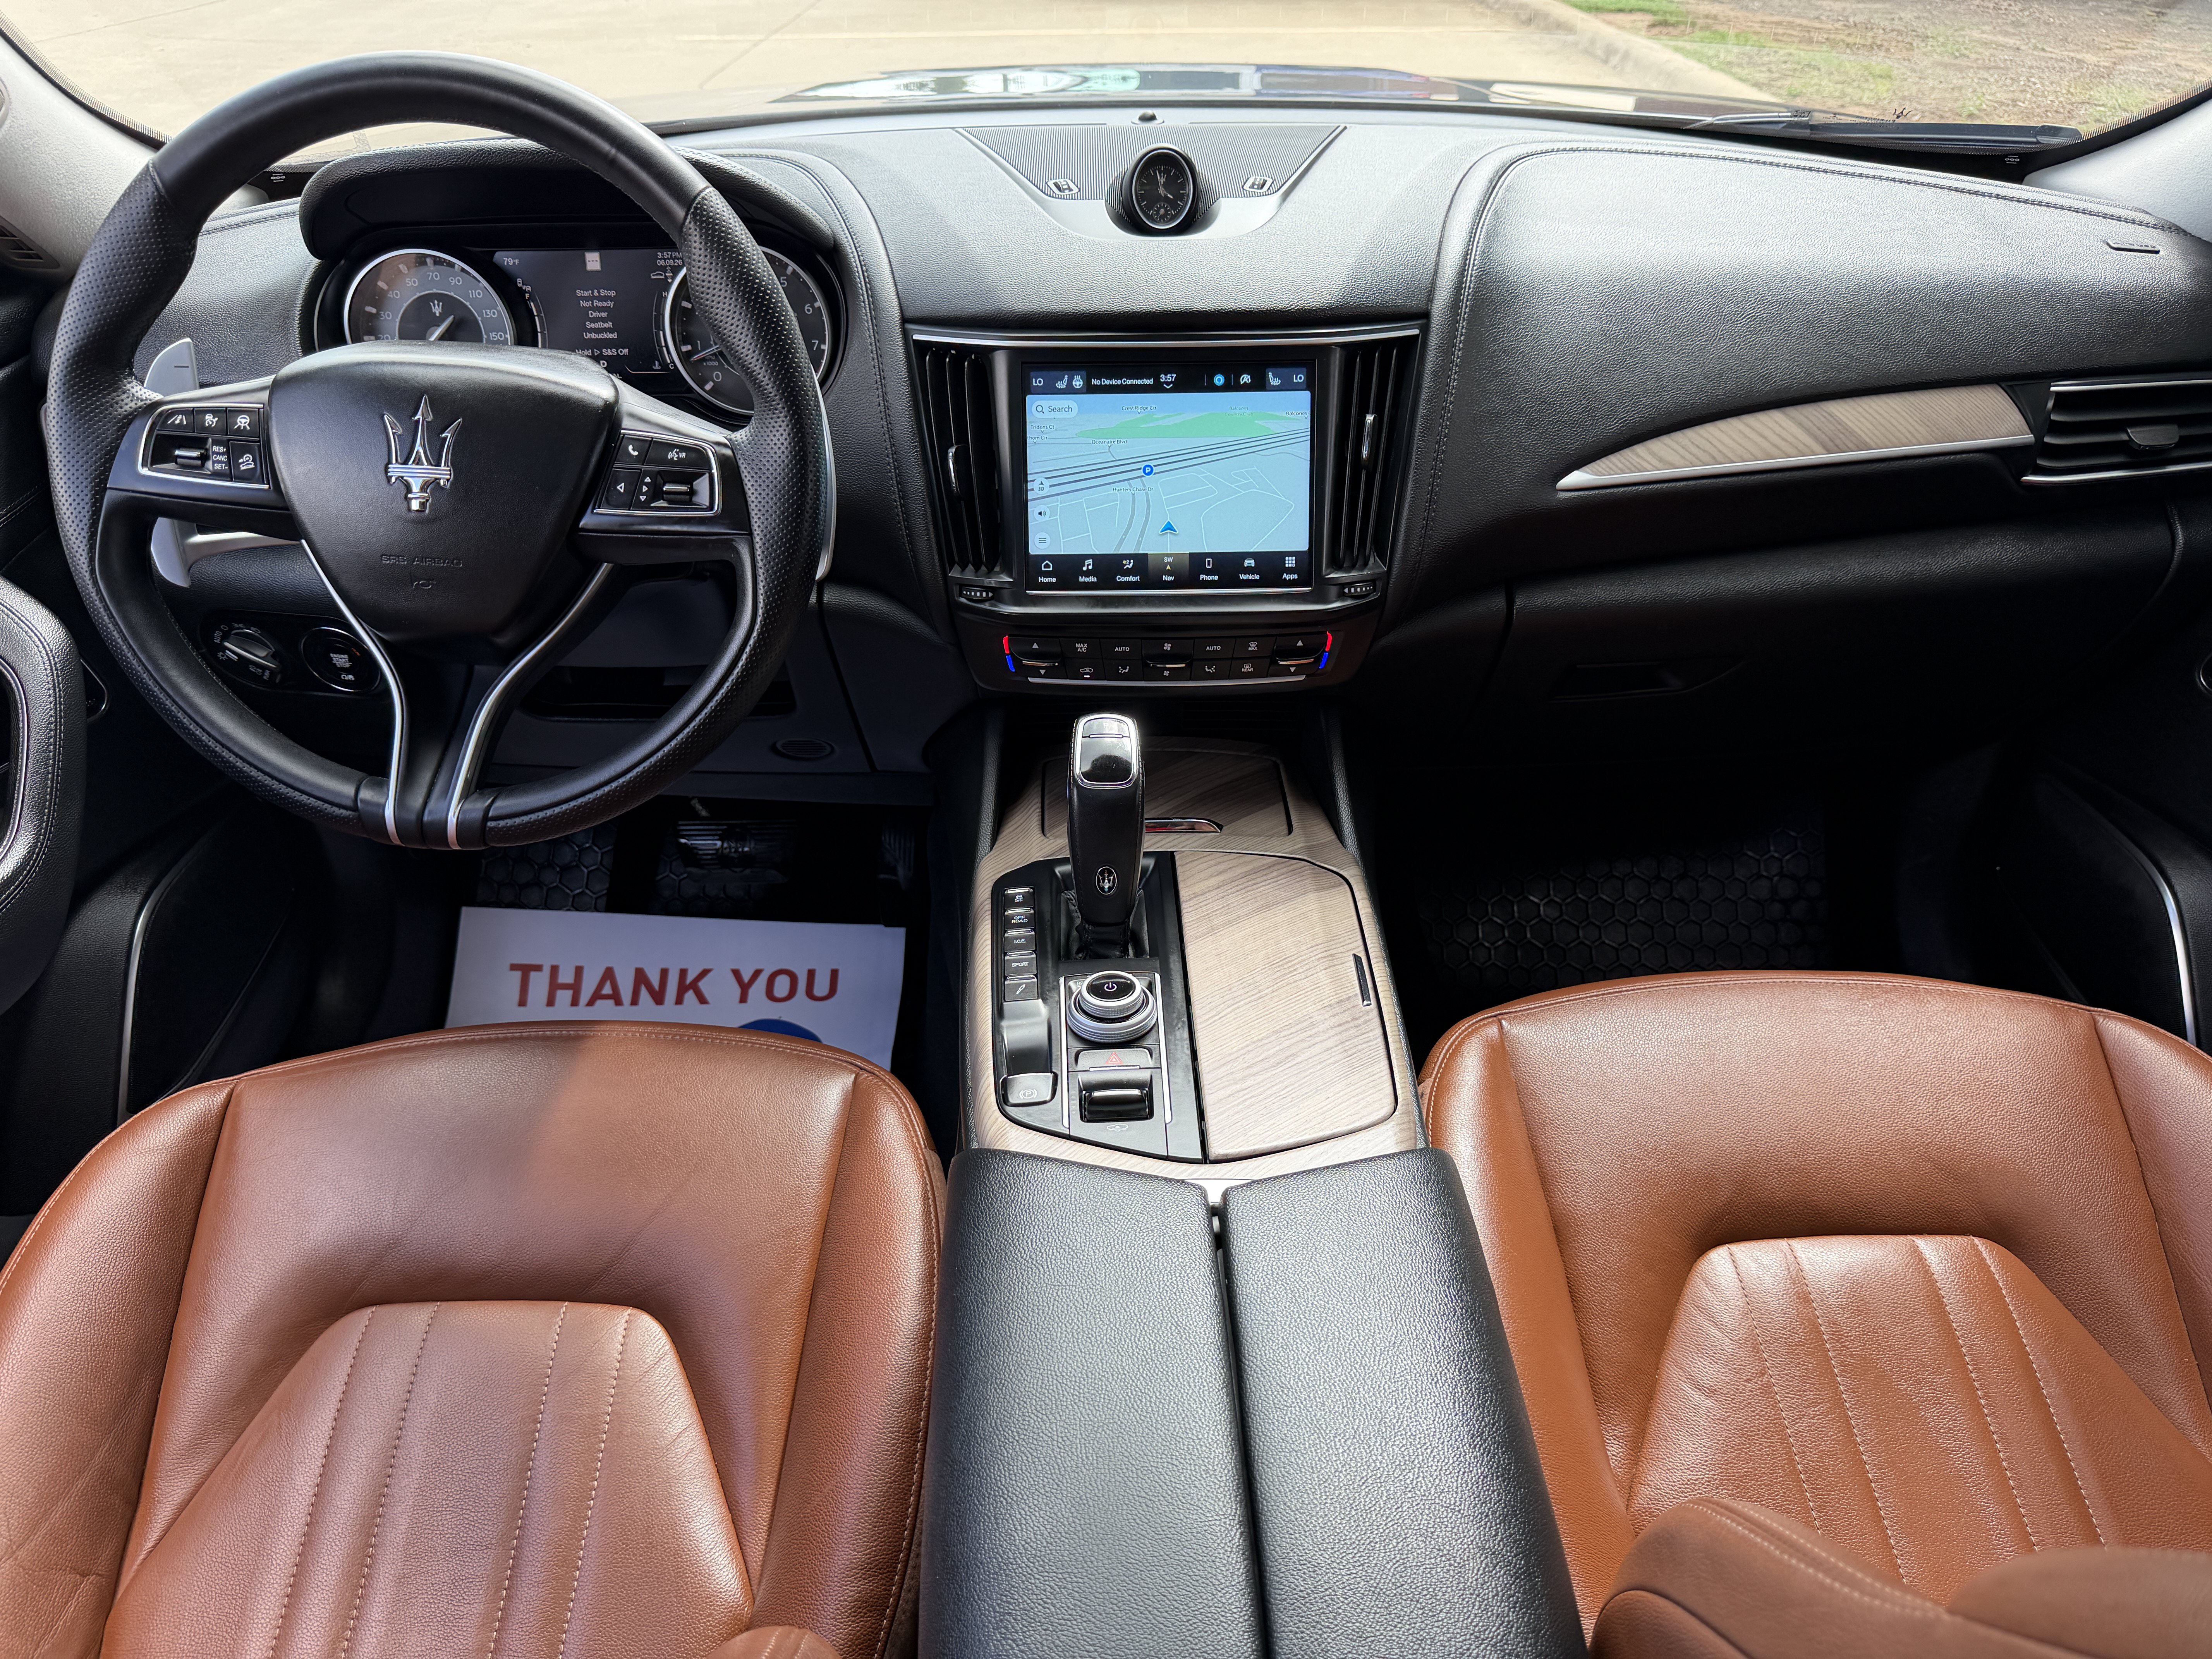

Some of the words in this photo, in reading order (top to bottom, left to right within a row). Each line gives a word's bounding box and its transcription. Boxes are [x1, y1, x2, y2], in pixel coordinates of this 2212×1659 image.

[427, 272, 440, 280] 70
[405, 278, 418, 287] 50
[449, 277, 462, 285] 90
[780, 276, 787, 287] 5
[387, 290, 400, 299] 40
[469, 290, 483, 298] 110
[600, 289, 616, 297] Stop
[483, 309, 497, 318] 130
[805, 304, 812, 314] 6
[489, 332, 503, 340] 150
[697, 340, 701, 350] 1
[812, 340, 819, 350] 7
[713, 372, 722, 381] 0
[413, 558, 463, 567] AIRBAG
[214, 631, 222, 643] AUTO
[509, 963, 713, 1007] THANK
[731, 967, 840, 1004] YOU
